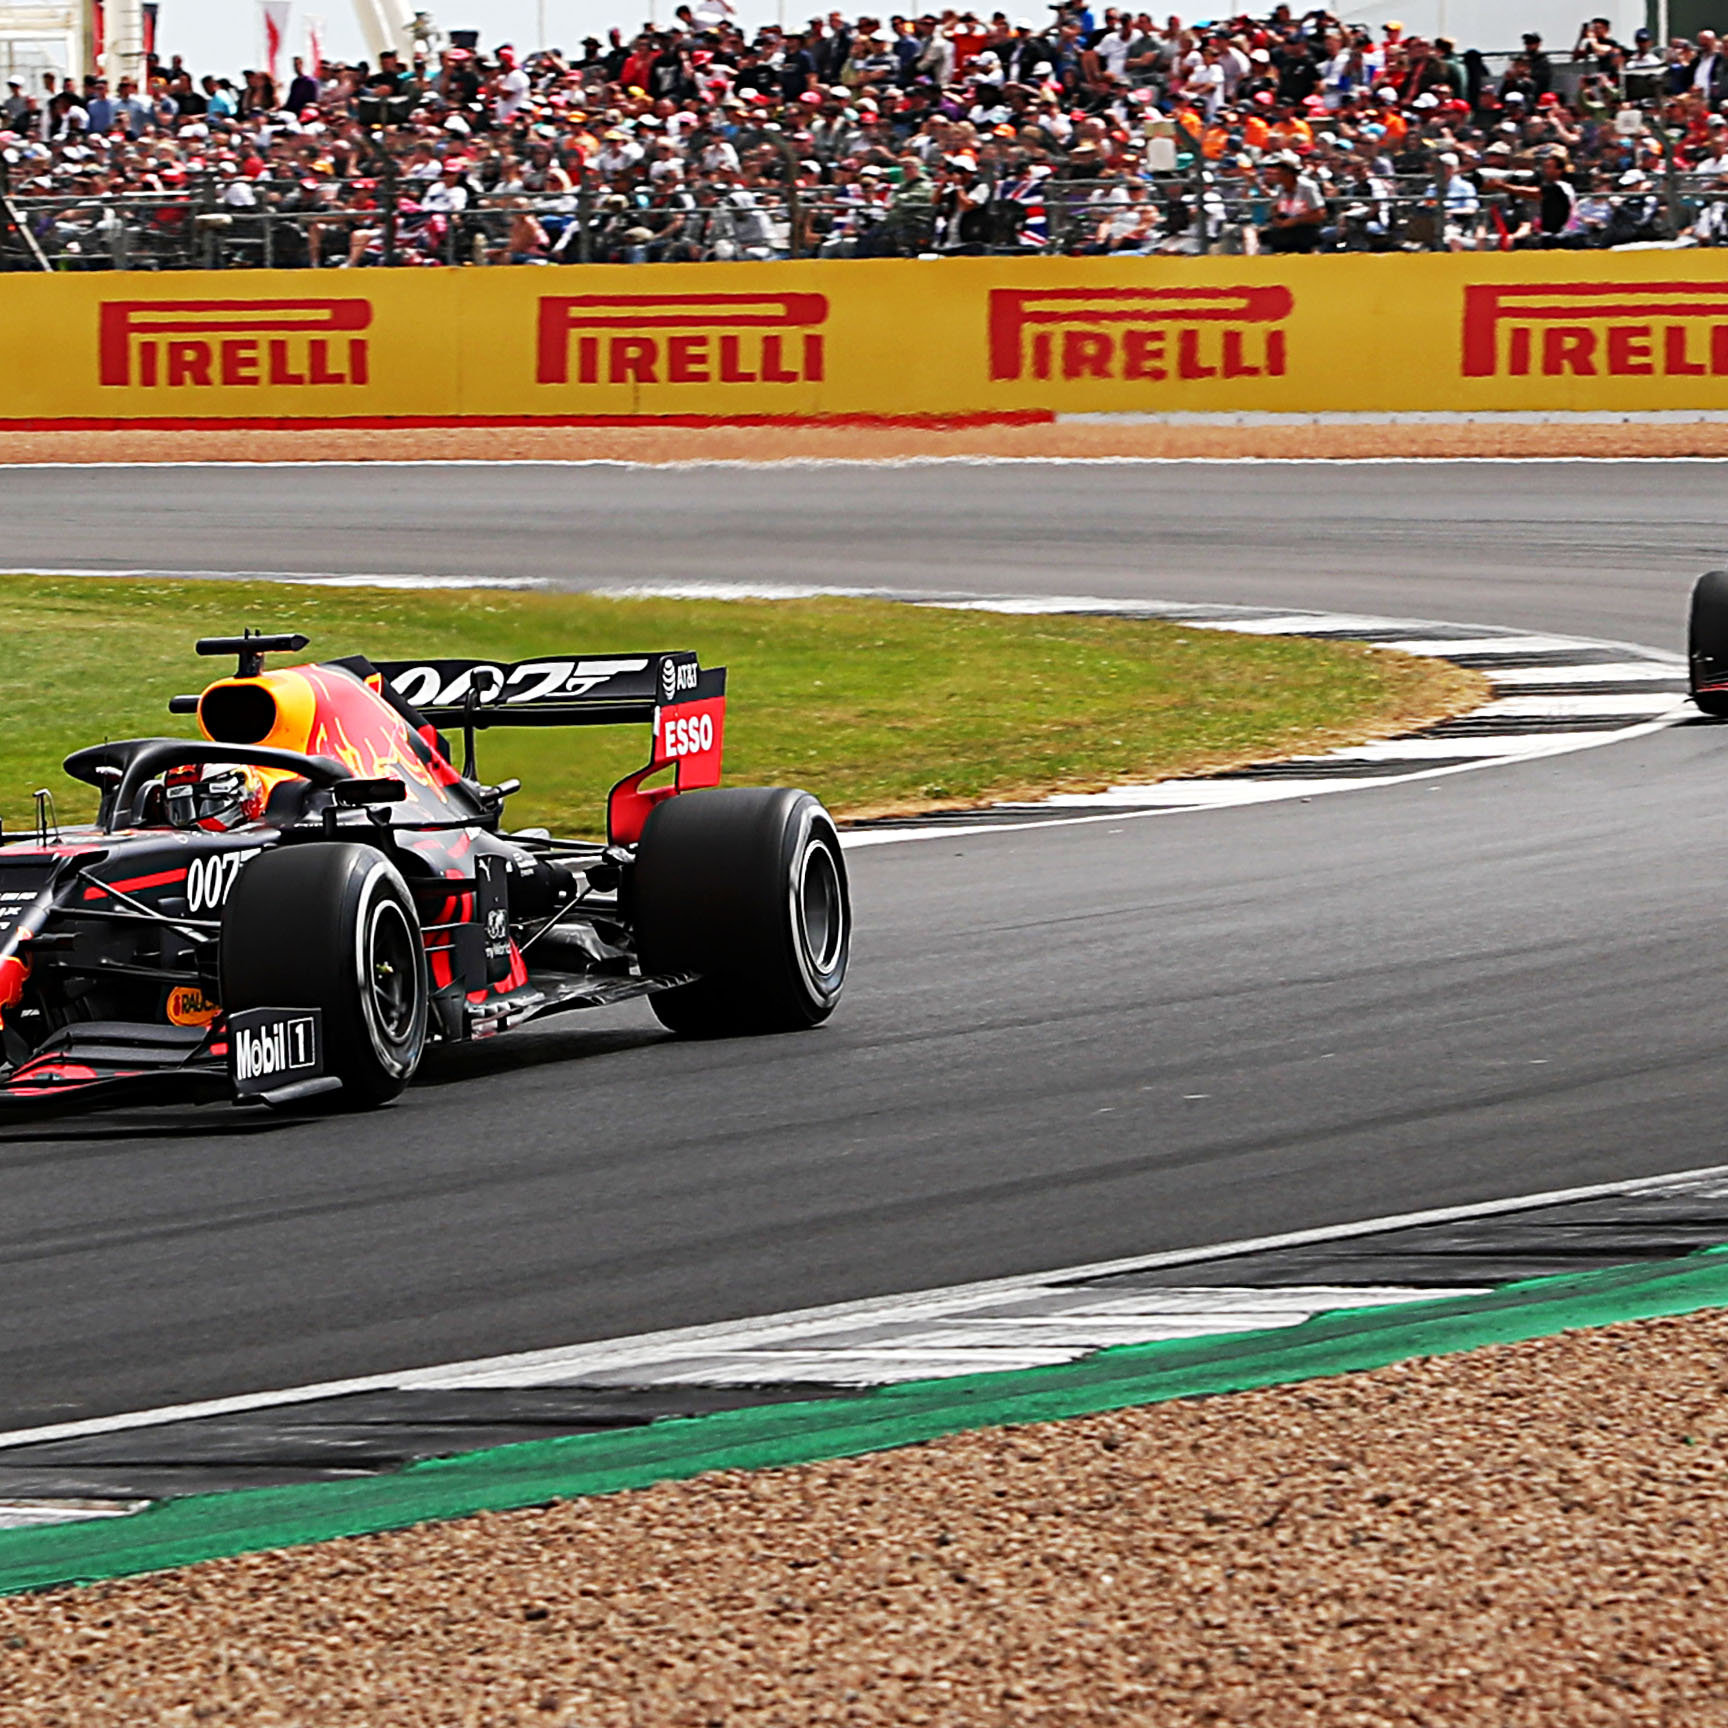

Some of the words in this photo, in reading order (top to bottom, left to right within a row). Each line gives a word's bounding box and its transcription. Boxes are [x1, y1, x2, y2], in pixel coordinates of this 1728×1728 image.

[98, 297, 374, 388] PIRELLI
[535, 291, 830, 386] PIRELLI
[987, 284, 1295, 382] PIRELLI
[676, 662, 698, 691] AT&T
[664, 713, 713, 758] ESSO
[187, 850, 242, 912] 007
[235, 1021, 286, 1081] Mobil
